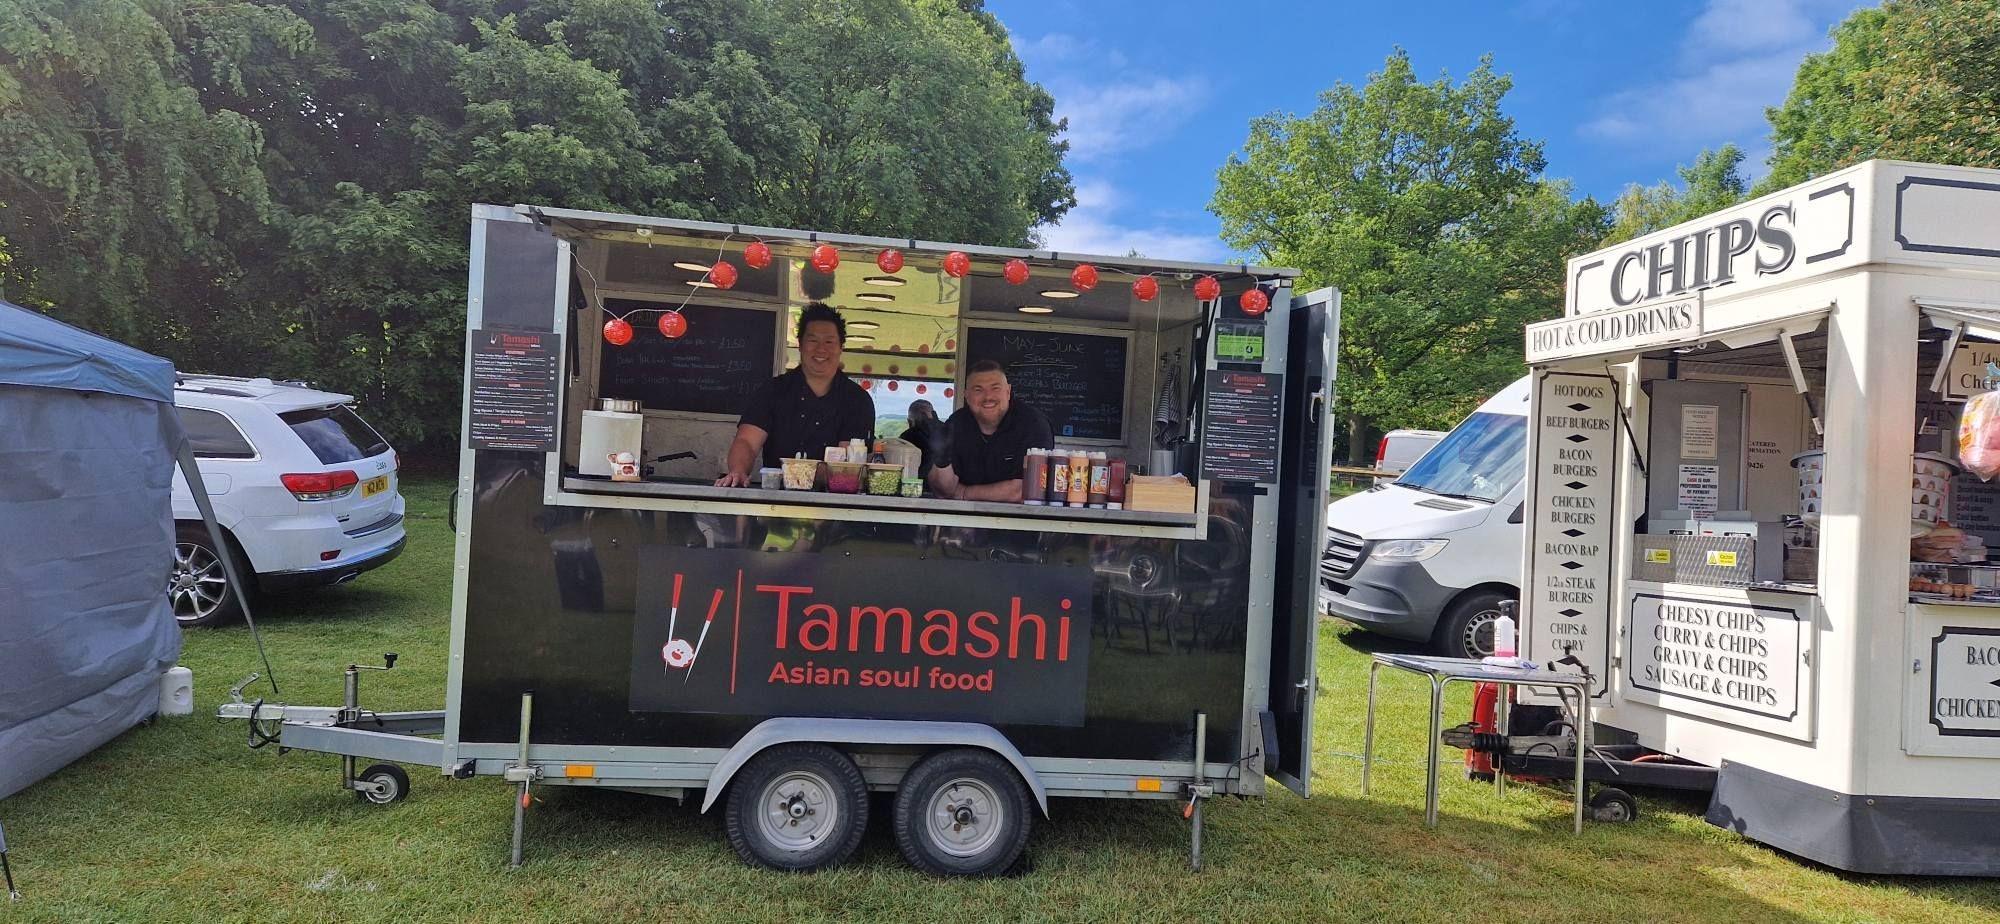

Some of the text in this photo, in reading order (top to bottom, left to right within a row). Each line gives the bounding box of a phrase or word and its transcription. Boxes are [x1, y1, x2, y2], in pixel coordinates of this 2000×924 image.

[1610, 200, 1797, 307] CHIPS
[1532, 303, 1693, 354] HOT & COLD DRINKS
[1960, 373, 2000, 390] Chee
[1554, 384, 1604, 399] HOT DOGS
[1546, 416, 1610, 431] BEEF BURGERS
[1559, 448, 1593, 461] BACON
[1553, 464, 1598, 477] BURGERS
[1552, 496, 1596, 509] CHICKEN
[1551, 511, 1596, 525] BURGERS
[1545, 542, 1599, 556] BACON BAP
[1565, 576, 1596, 590] STEAK
[1549, 590, 1594, 604] BURGERS
[756, 584, 1072, 662] Tamashi
[1657, 603, 1766, 634] CHEESY CHIPS
[1550, 622, 1588, 636] CHIPS &
[1653, 624, 1769, 658] CURRY & CHIPS
[1653, 645, 1768, 682] GRAVY & CHIPS
[1966, 645, 2000, 666] BAC
[768, 661, 994, 692] Asian soul food
[1644, 664, 1778, 707] SAUSAGE & CHIPS
